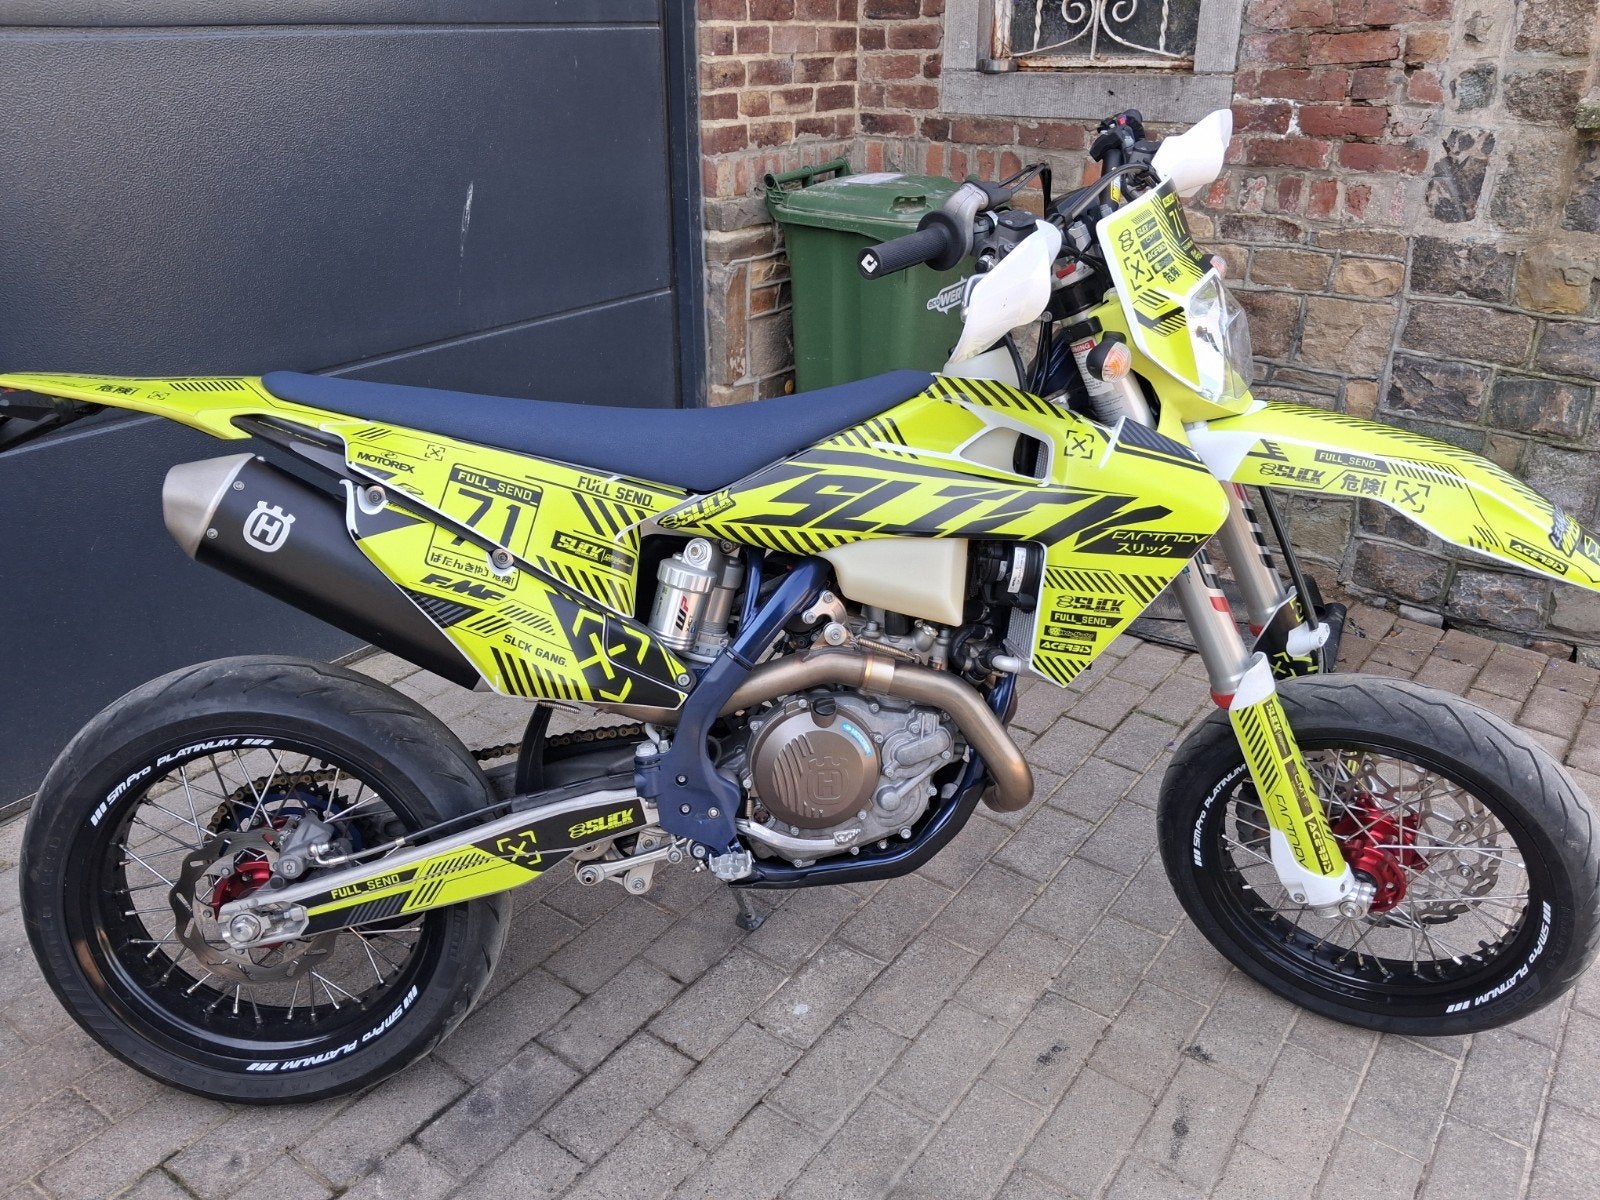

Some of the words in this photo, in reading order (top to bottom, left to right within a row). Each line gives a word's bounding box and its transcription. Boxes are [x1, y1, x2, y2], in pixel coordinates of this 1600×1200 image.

[357, 451, 415, 474] MOTOREX
[577, 475, 610, 497] FULL
[615, 486, 654, 508] SEND.
[451, 487, 522, 549] 71
[1115, 542, 1173, 556] スリック
[420, 573, 506, 601] FMF
[1072, 597, 1126, 612] SLICK
[503, 634, 533, 653] SLCK
[535, 647, 567, 667] GANG.
[1041, 641, 1091, 654] ACERBIS
[157, 738, 238, 767] PLATINUM
[1204, 763, 1247, 808] PLATINUM
[585, 807, 634, 835] SLICK
[1309, 822, 1334, 874] ACERBIS
[1474, 963, 1529, 1006] PLATINUM
[280, 1039, 358, 1070] PLATINUM
